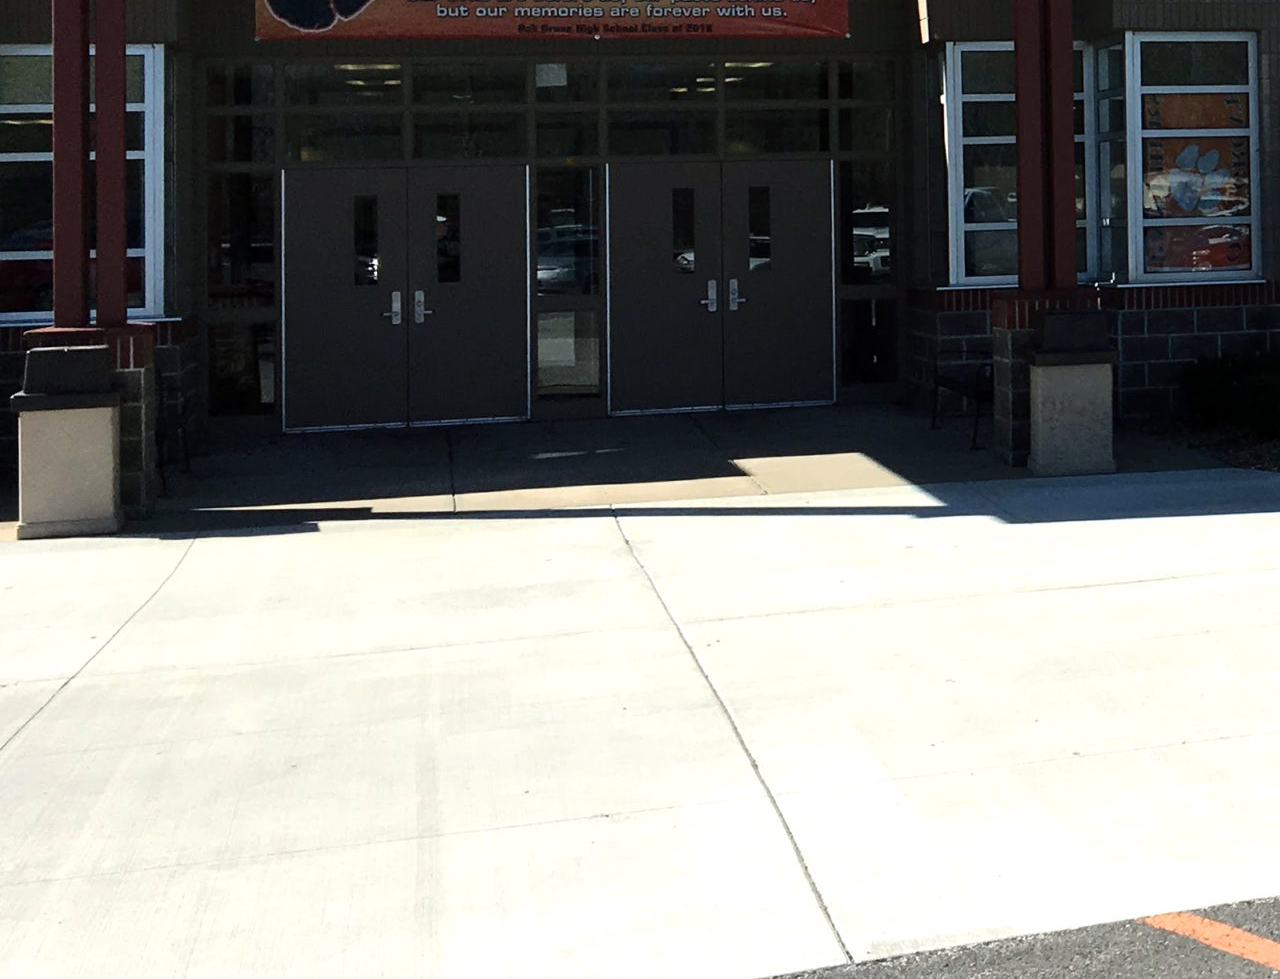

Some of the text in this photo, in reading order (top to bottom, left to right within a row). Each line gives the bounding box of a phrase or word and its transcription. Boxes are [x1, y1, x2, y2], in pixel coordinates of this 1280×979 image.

[436, 4, 787, 16] but our memories are forever with us.
